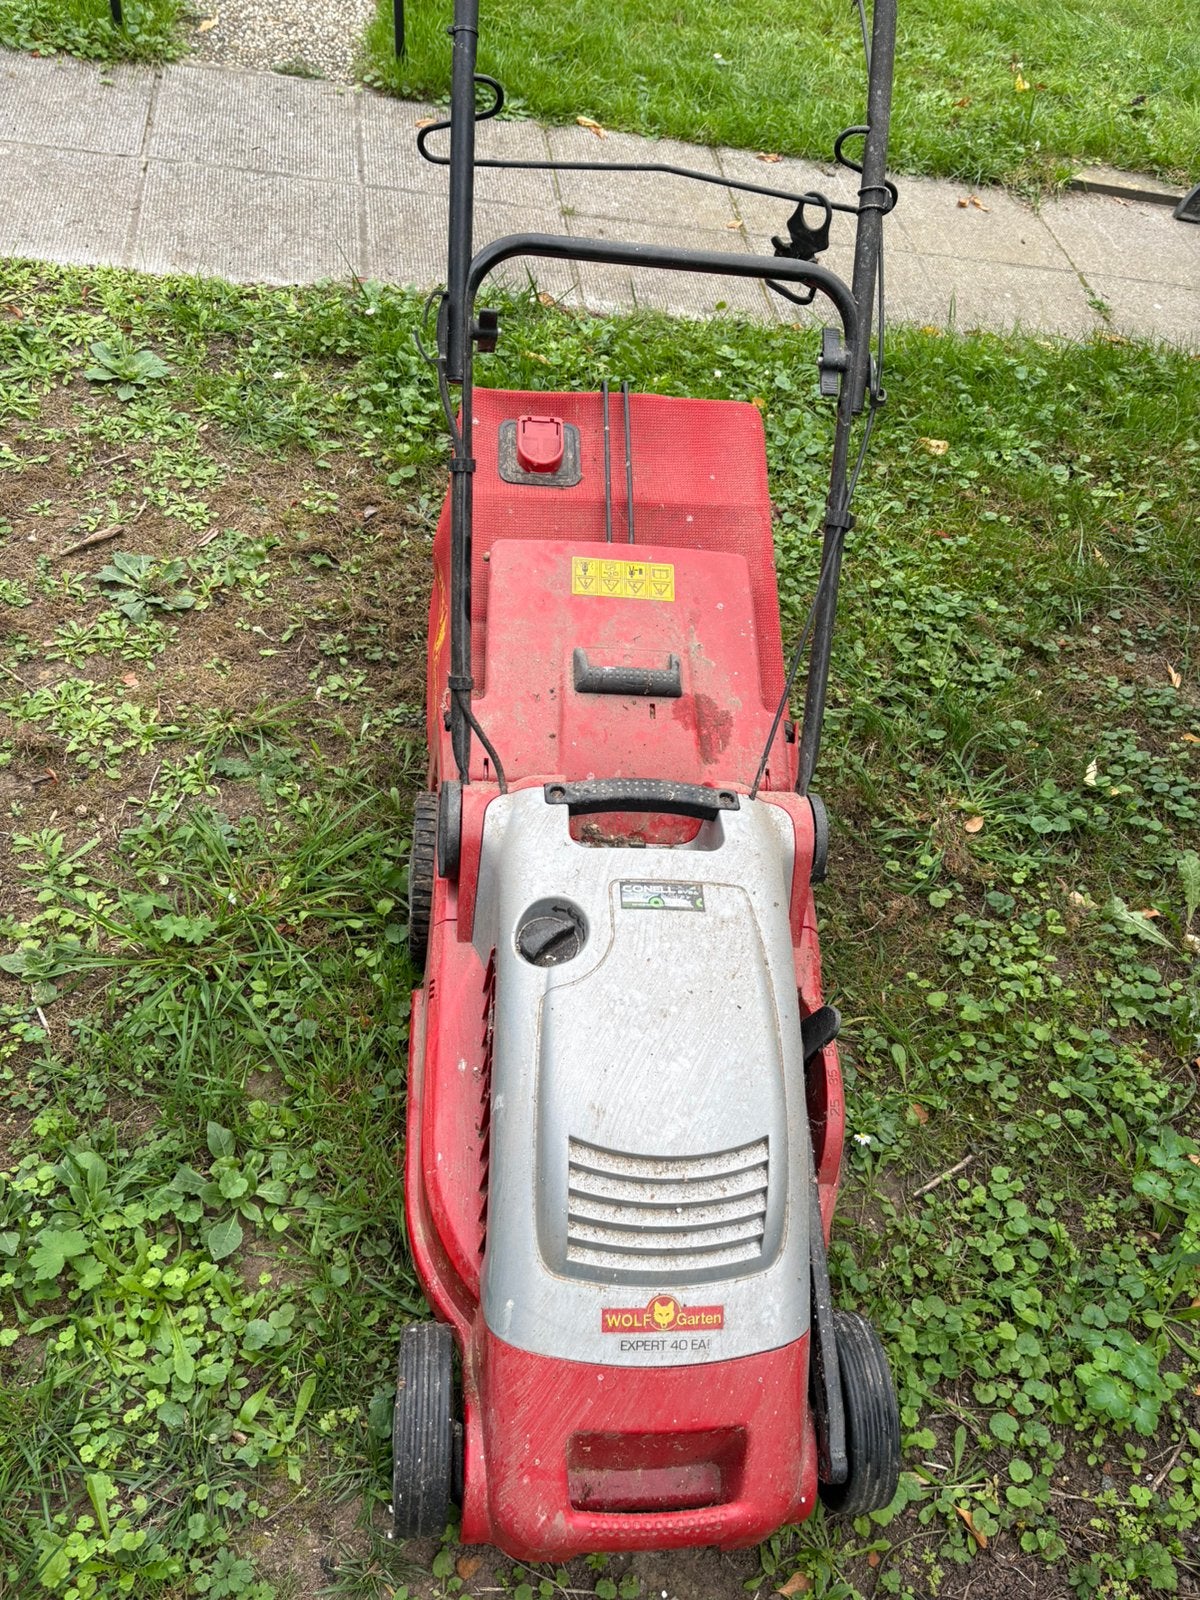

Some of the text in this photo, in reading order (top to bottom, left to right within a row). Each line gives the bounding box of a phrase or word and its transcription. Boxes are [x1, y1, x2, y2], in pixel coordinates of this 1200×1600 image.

[828, 1069, 838, 1086] 35
[830, 1099, 840, 1117] 25
[606, 1312, 722, 1328] WOLF Garten
[620, 1340, 667, 1352] EXPERT
[670, 1339, 688, 1351] 40
